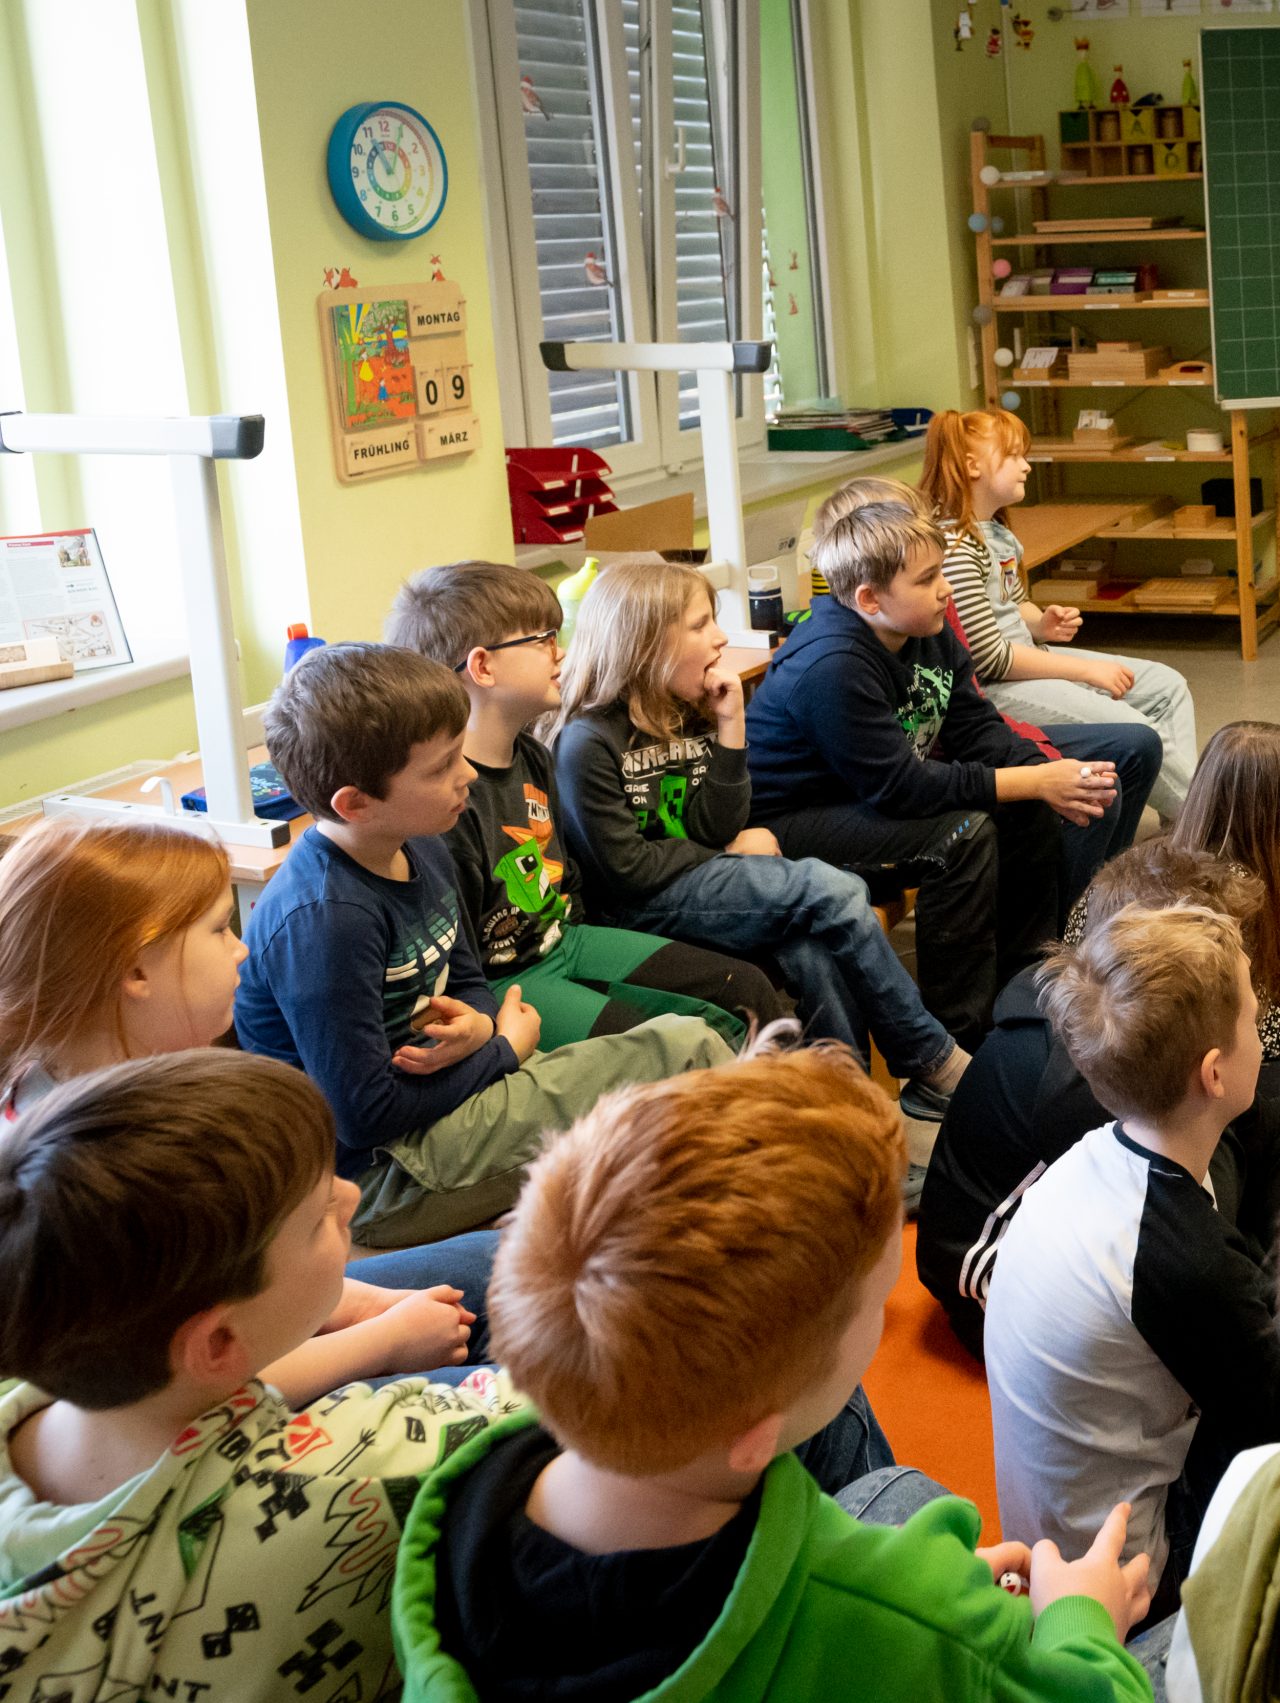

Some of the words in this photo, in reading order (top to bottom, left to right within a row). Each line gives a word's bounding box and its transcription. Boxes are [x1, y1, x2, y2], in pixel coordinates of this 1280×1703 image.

[362, 126, 373, 138] 11
[378, 121, 390, 133] 12
[352, 143, 363, 156] 10
[411, 142, 419, 154] 2
[351, 166, 360, 178] 9
[419, 164, 426, 177] 3
[360, 189, 367, 201] 8
[415, 186, 424, 198] 4
[375, 205, 382, 217] 7
[391, 209, 399, 221] 6
[408, 204, 415, 216] 5
[417, 311, 461, 326] MONTAG
[440, 431, 469, 446] MÄRZ
[353, 439, 410, 460] FRÜHLING
